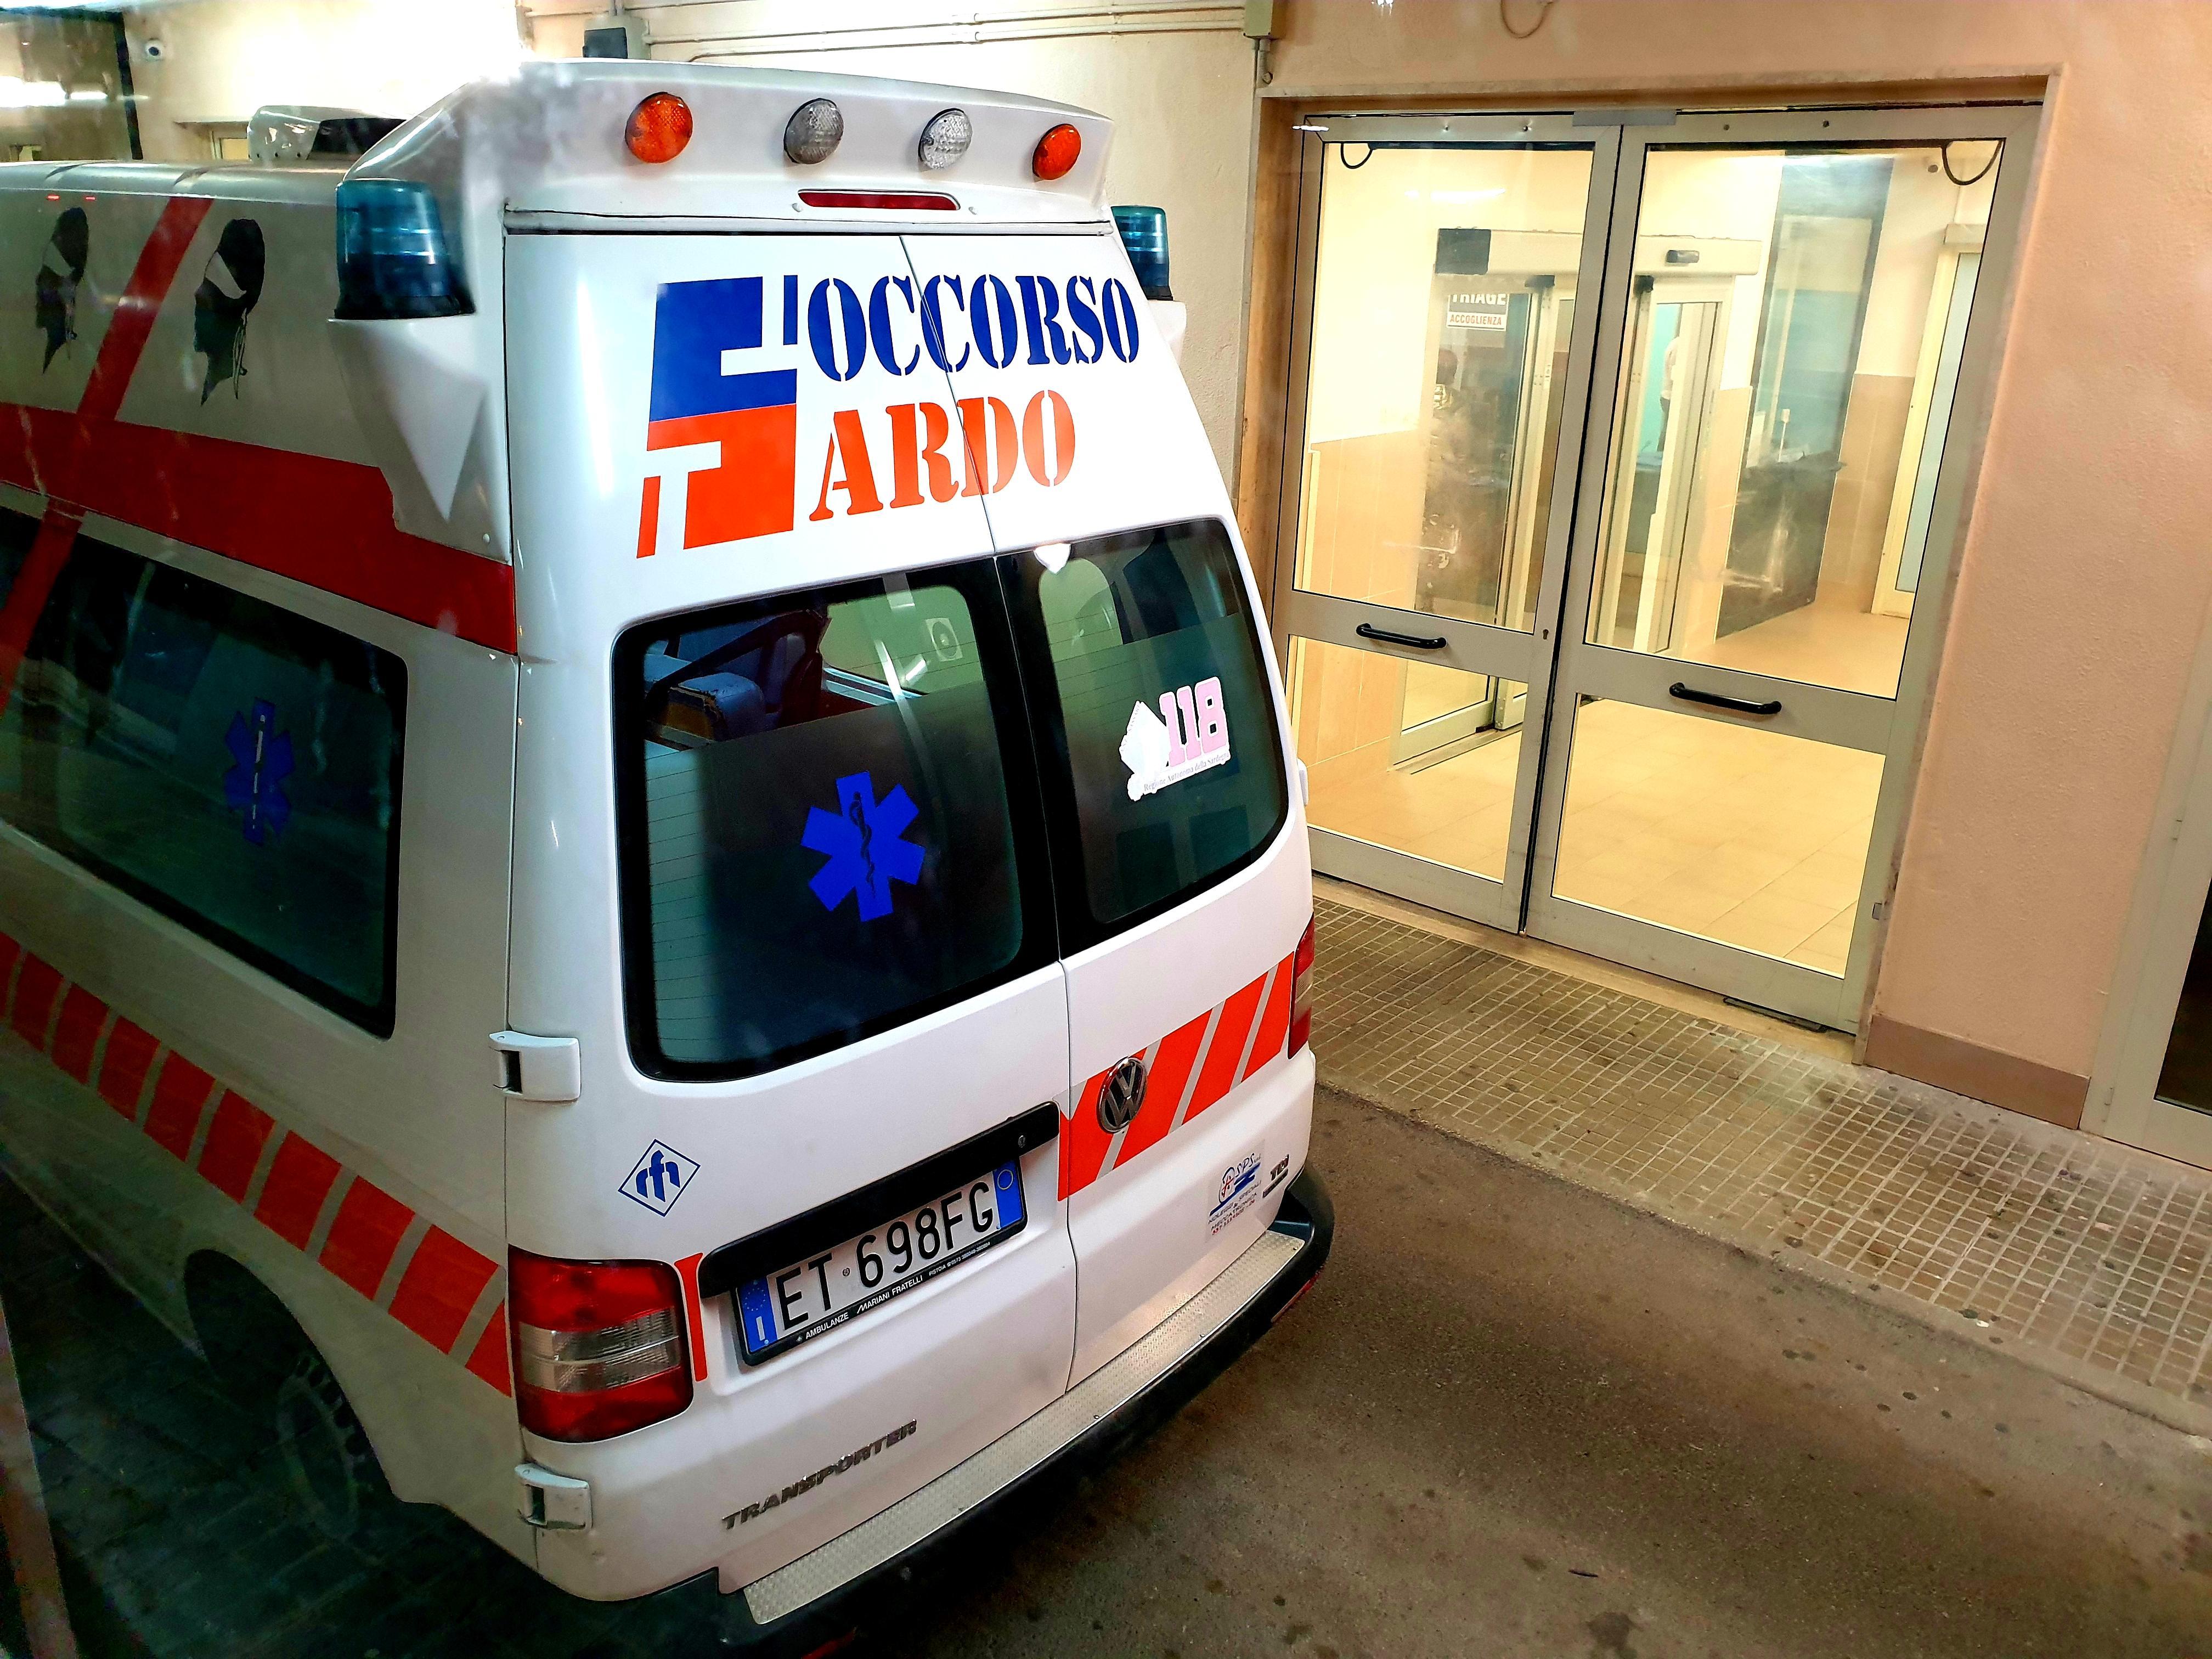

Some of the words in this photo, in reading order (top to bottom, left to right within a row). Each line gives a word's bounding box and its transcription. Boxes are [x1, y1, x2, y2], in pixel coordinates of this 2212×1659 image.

[808, 273, 1139, 382] OCCORSO
[1449, 314, 1502, 325] ACCOGLIENZA
[809, 390, 1075, 522] ARDO
[1159, 678, 1228, 768] 118
[776, 1253, 832, 1330] ET
[856, 1181, 994, 1289] 698FG
[805, 1312, 849, 1339] AMBULANZE
[857, 1291, 890, 1314] MARIANI
[892, 1276, 923, 1295] FRATELLI
[722, 1418, 917, 1530] TRANSPORTER
